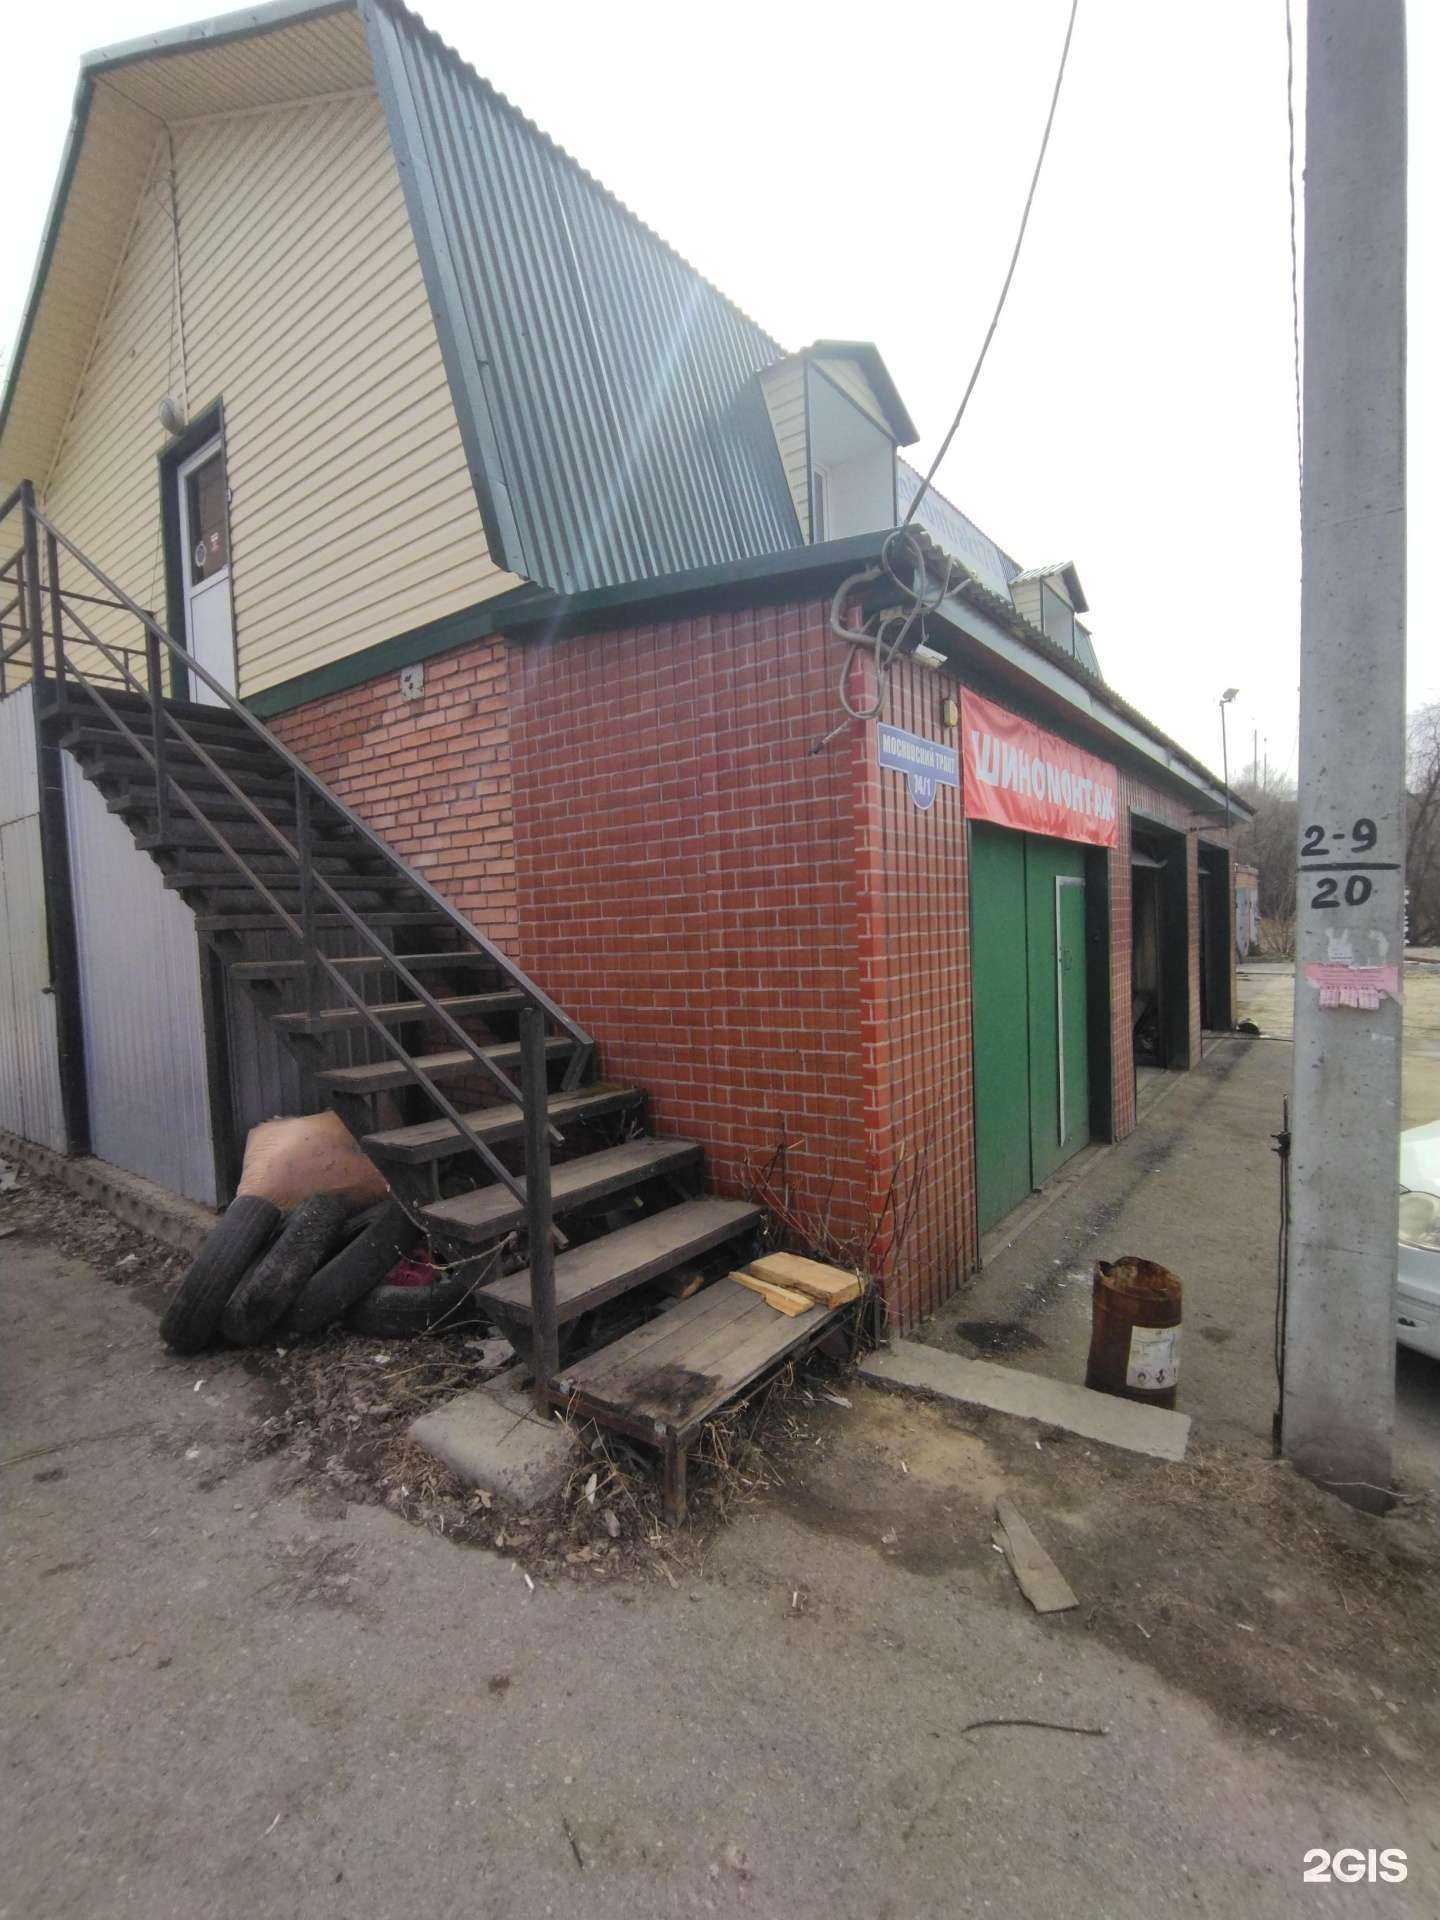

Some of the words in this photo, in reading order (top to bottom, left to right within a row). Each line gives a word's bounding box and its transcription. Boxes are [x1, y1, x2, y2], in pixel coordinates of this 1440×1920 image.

[882, 733, 935, 769] МОСКОВСКИЙ
[971, 730, 1116, 821] ШИНОМОНТАЖ
[1301, 818, 1377, 856] 2-9
[1311, 875, 1372, 909] 20
